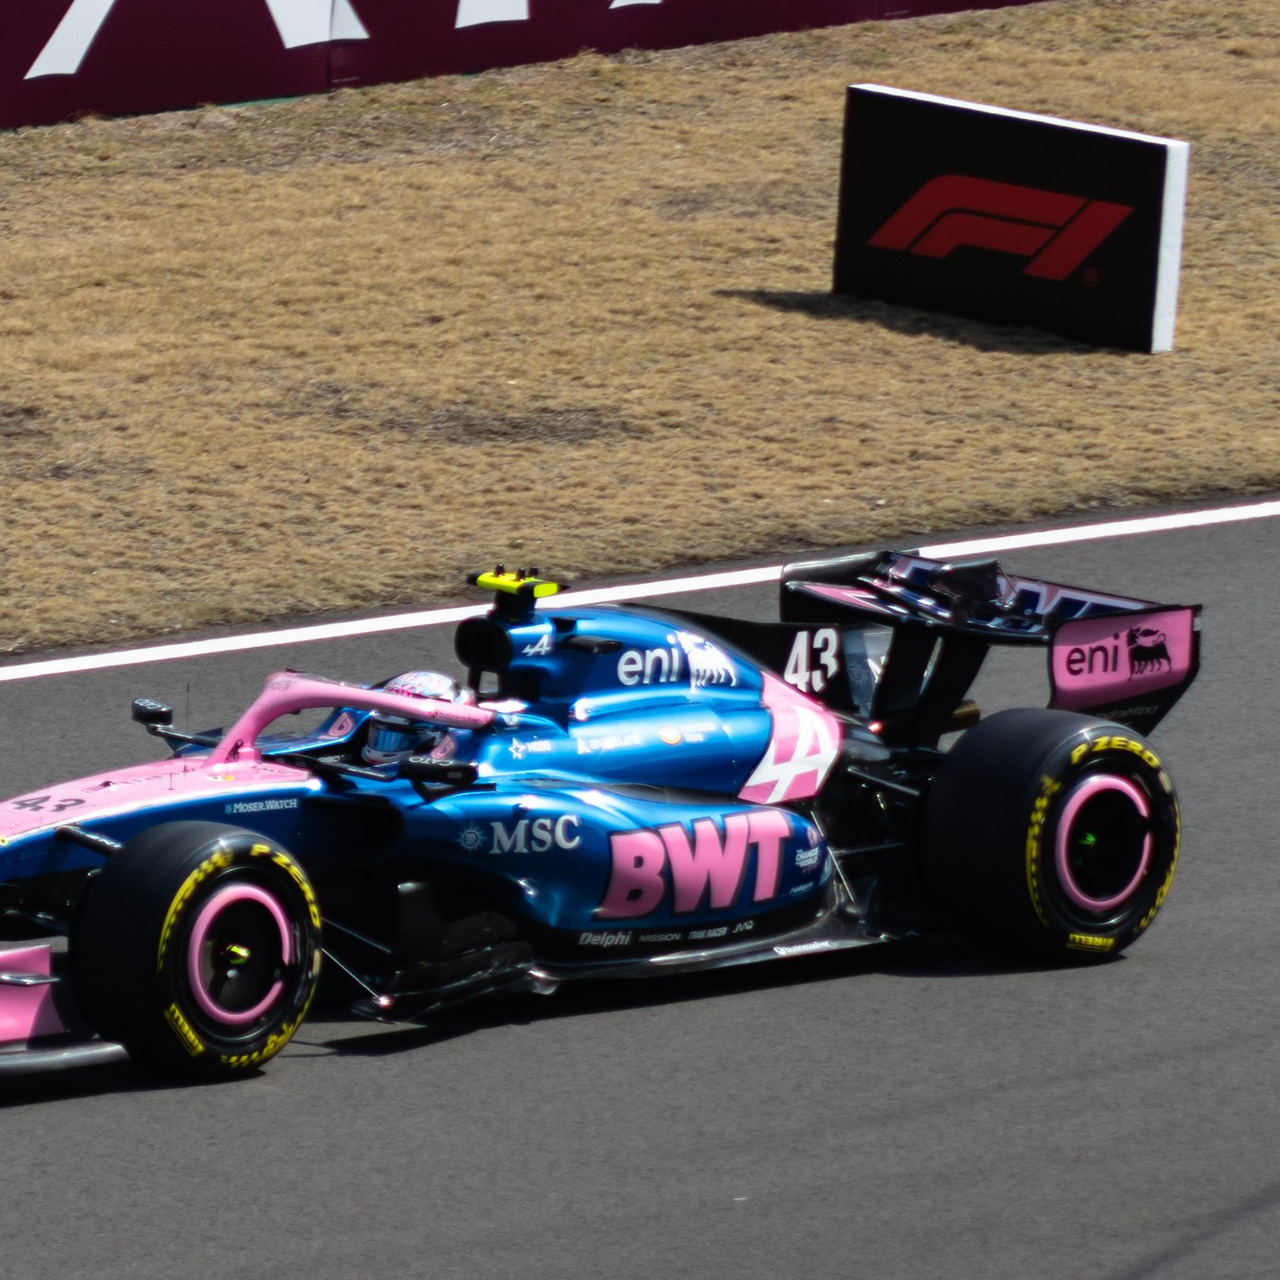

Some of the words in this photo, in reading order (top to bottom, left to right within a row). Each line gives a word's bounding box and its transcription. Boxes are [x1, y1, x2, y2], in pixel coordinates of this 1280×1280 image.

[867, 174, 1134, 282] F1
[617, 634, 679, 687] eni
[783, 628, 840, 693] 43
[1065, 632, 1120, 676] eni
[1071, 743, 1089, 765] P
[1091, 735, 1161, 768] ZERO
[11, 794, 86, 813] 43
[232, 798, 298, 814] MOSER.WATCH
[489, 814, 582, 855] MSC
[594, 805, 793, 921] BWT
[578, 931, 633, 948] Delphi
[638, 933, 681, 943] MISSION
